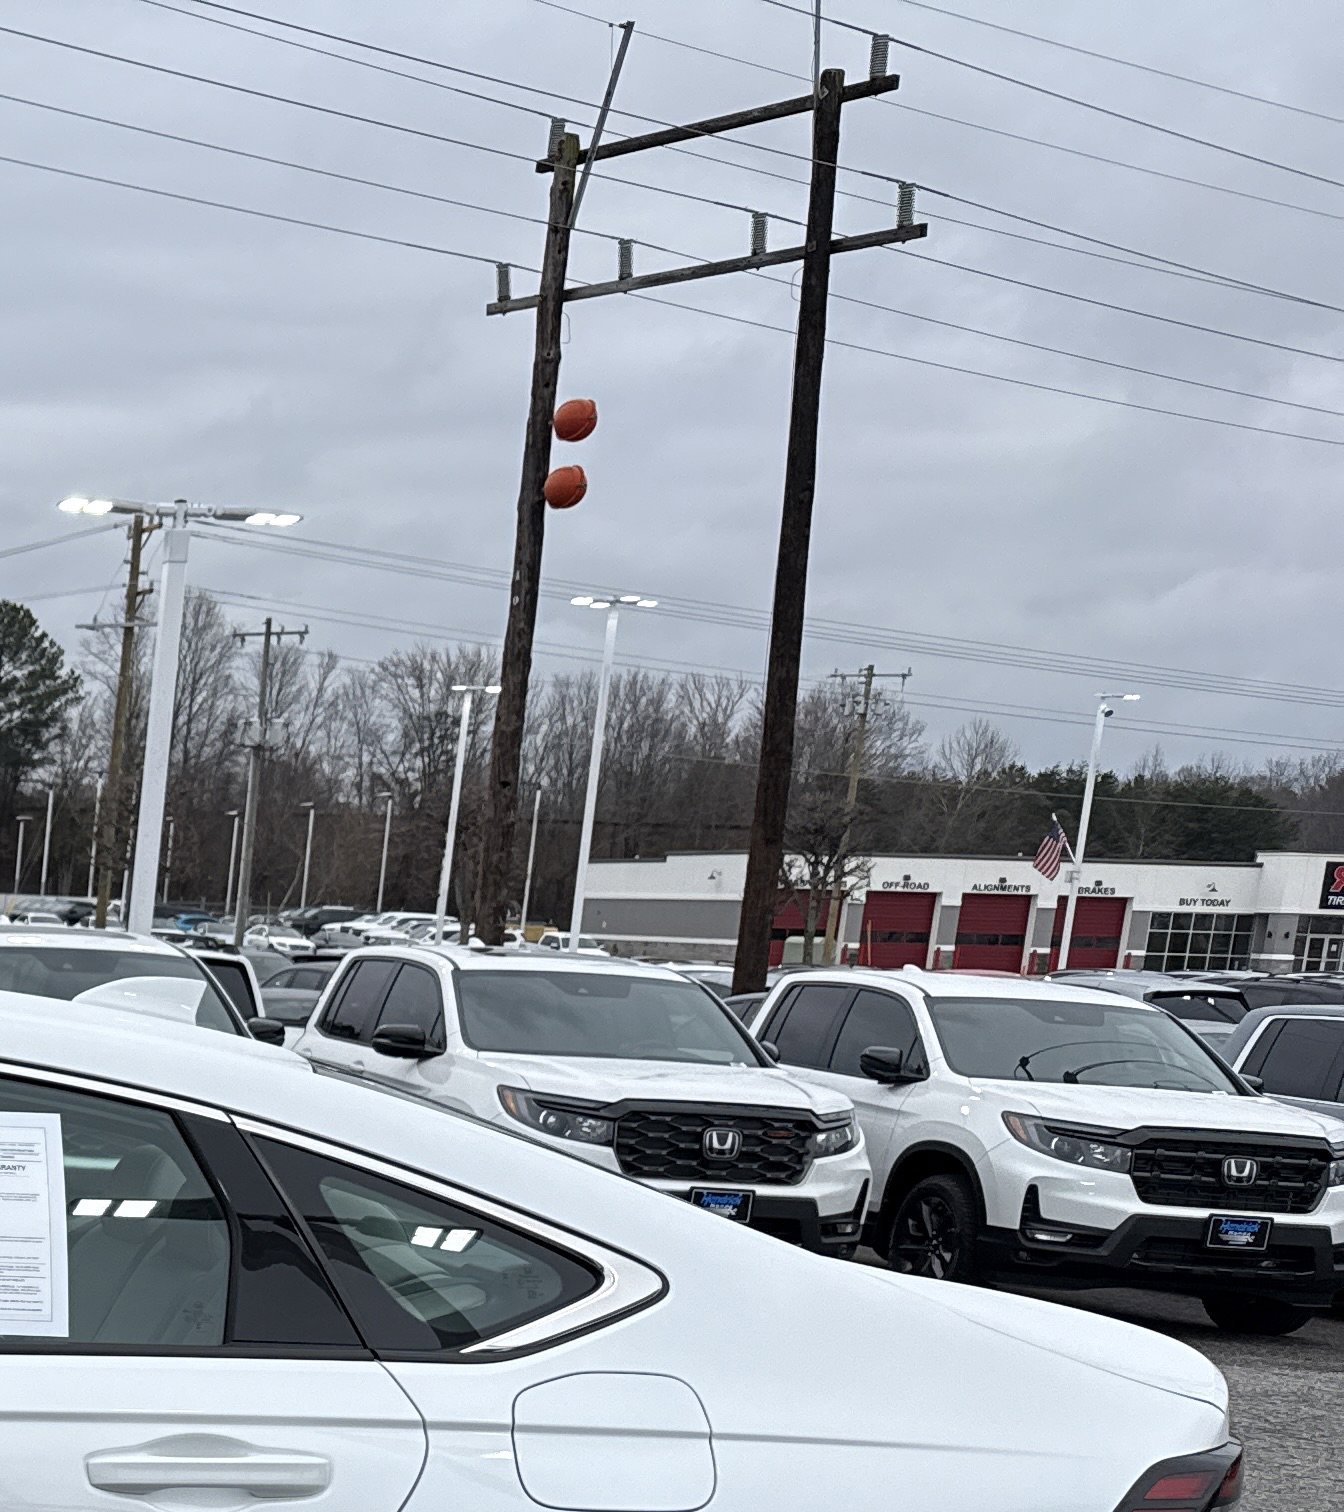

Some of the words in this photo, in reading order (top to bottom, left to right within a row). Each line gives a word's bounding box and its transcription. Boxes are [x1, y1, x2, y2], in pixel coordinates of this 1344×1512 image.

[881, 881, 930, 891] OFF-ROAD
[971, 883, 1032, 893] ALIGNMENTS
[1077, 886, 1116, 896] BRAKES
[1179, 898, 1198, 907] BUY
[1200, 898, 1231, 908] TODAY
